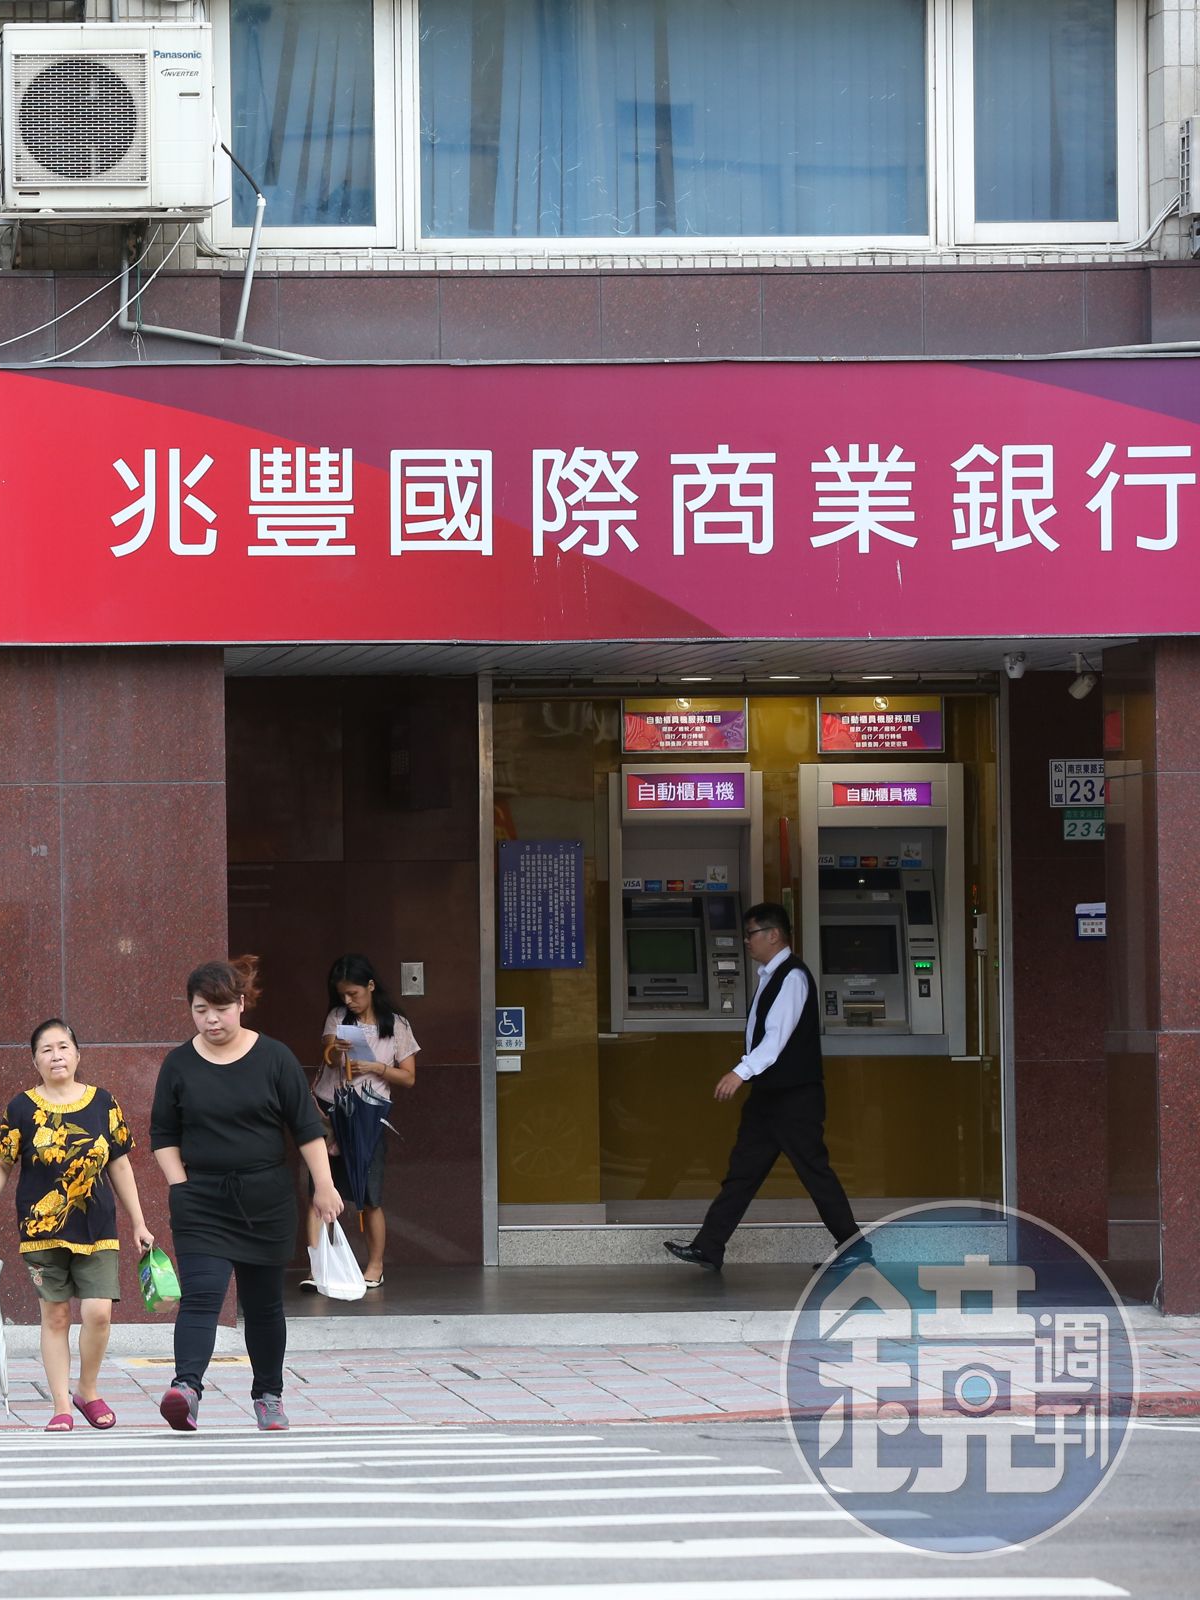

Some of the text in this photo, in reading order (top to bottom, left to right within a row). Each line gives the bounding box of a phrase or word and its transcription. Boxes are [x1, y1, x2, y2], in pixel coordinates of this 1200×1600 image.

[153, 50, 202, 59] Panasonic
[162, 69, 199, 77] INVERTER
[110, 441, 1197, 559] 兆豐國際商業銀行
[1053, 763, 1064, 803] 松山區
[638, 781, 735, 802] 自動櫃員機
[846, 787, 918, 803] 自動櫃員機
[623, 880, 641, 888] VISA
